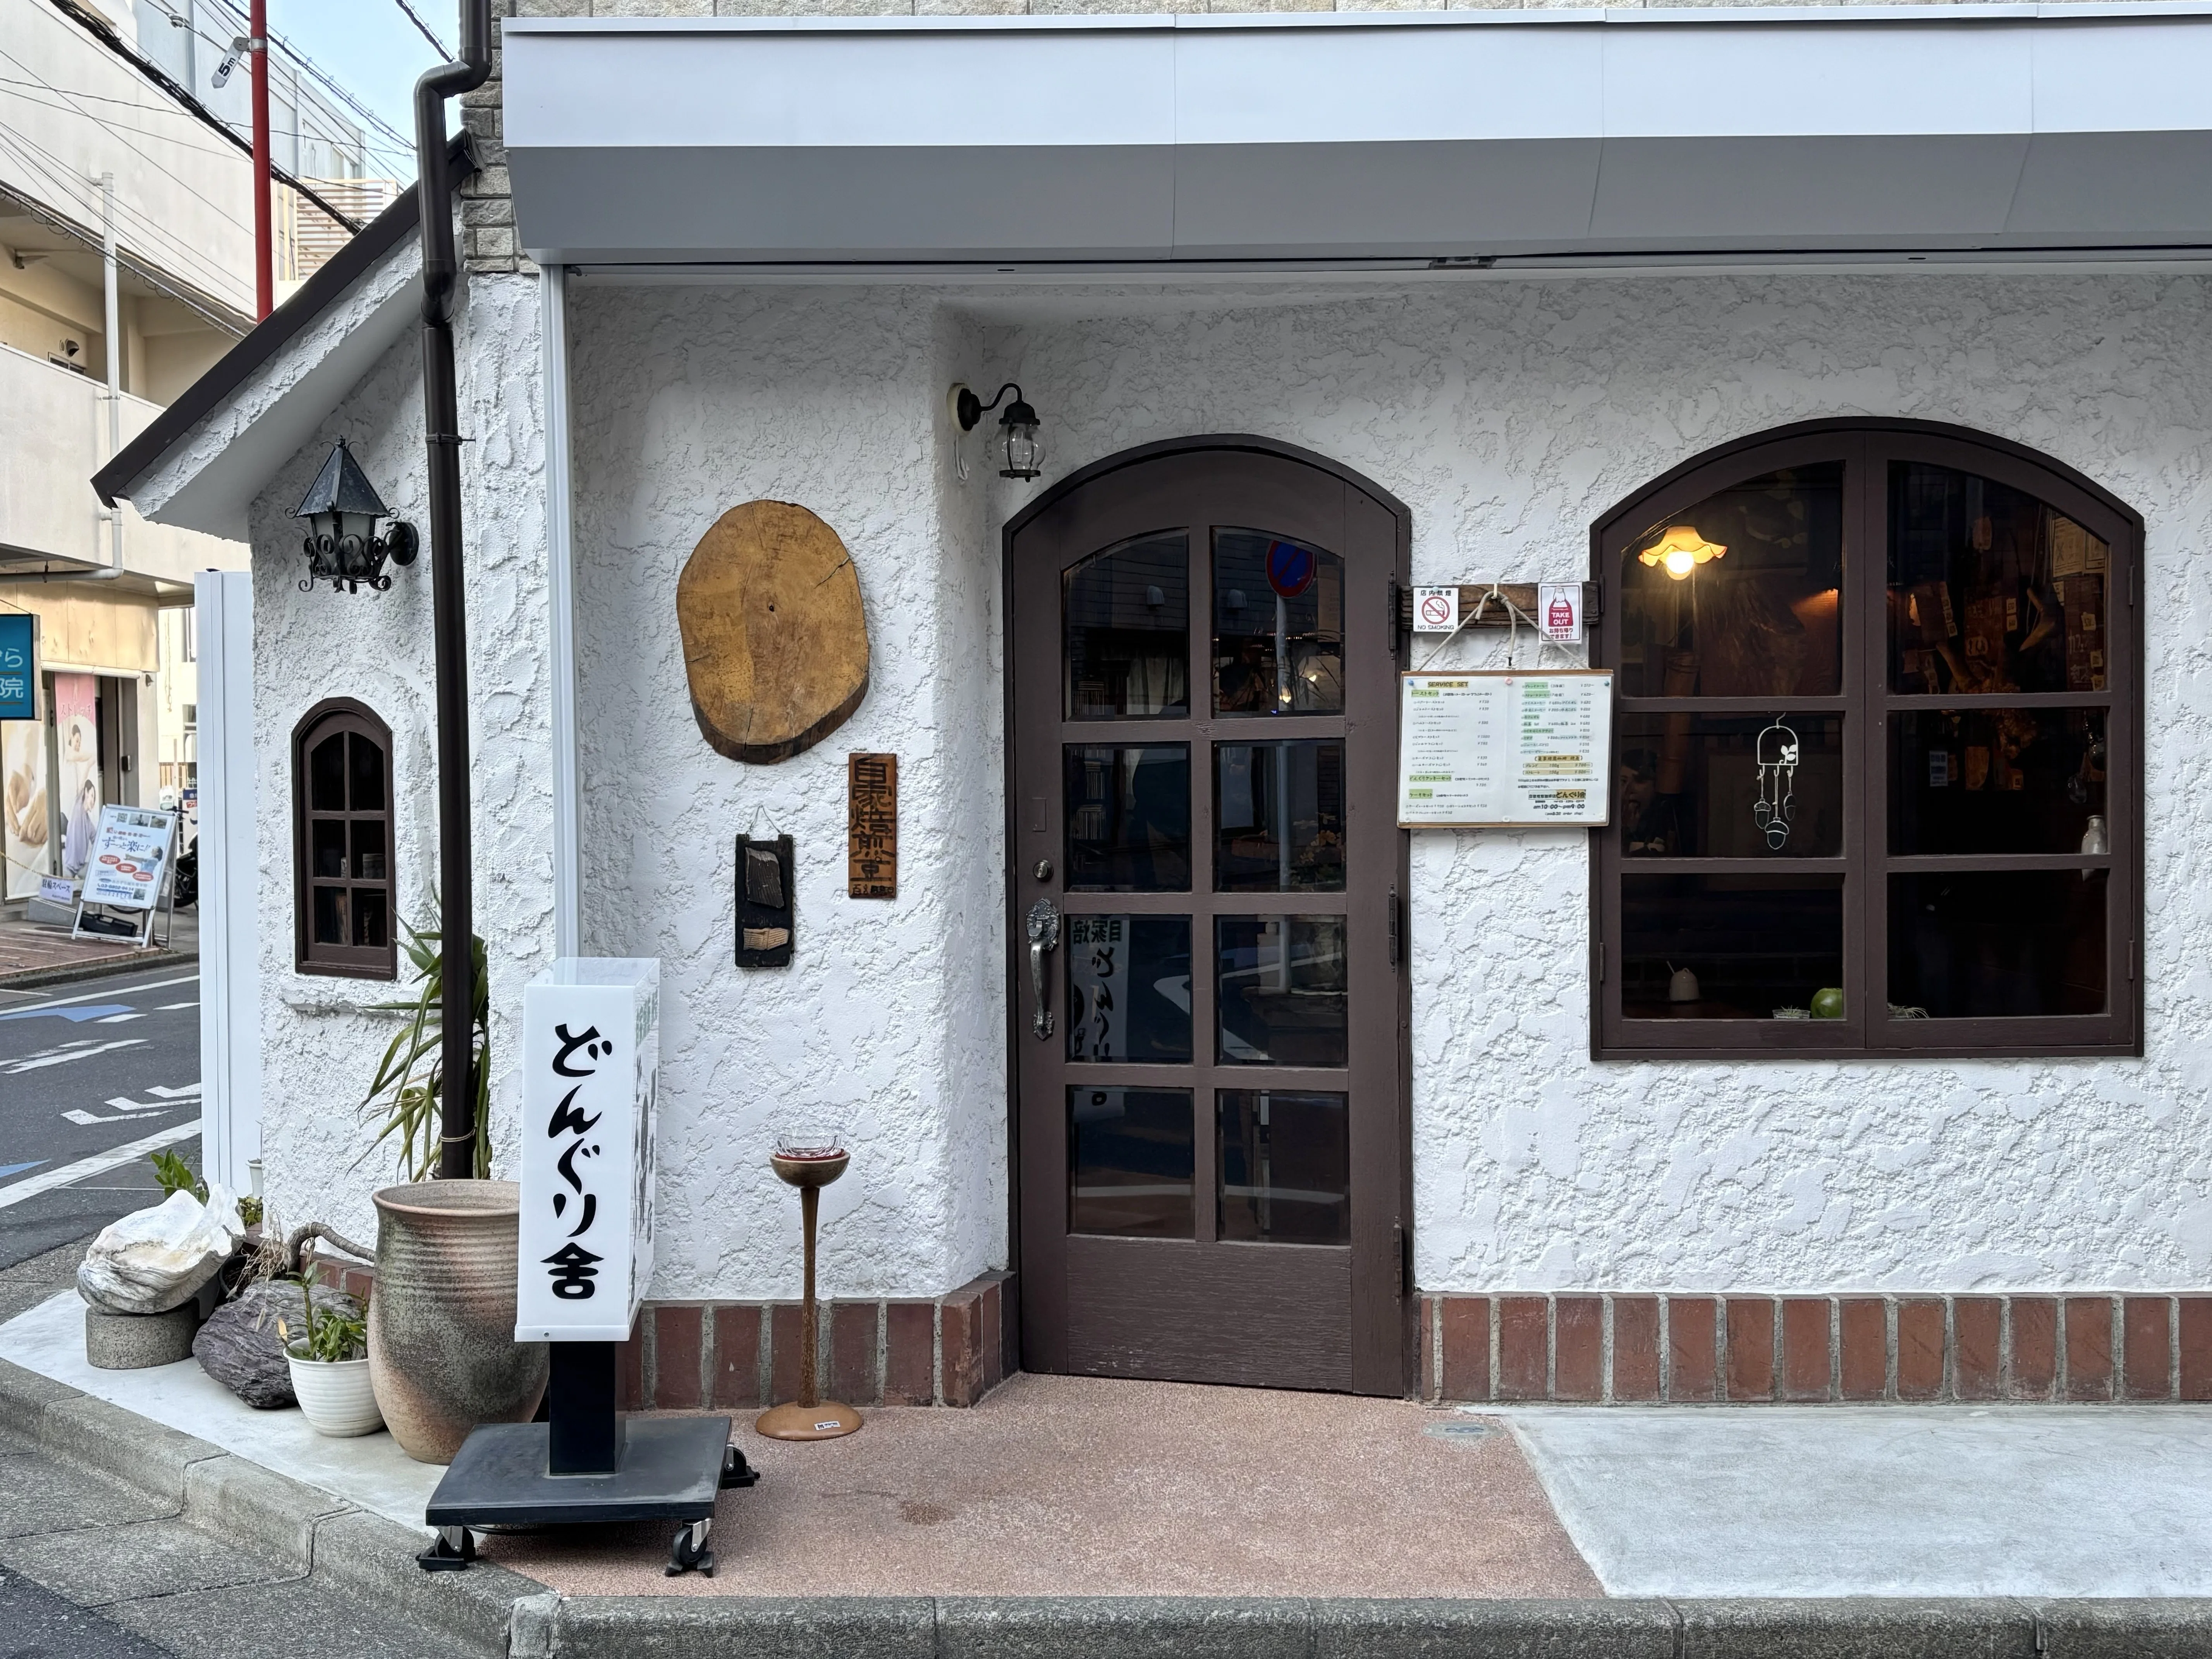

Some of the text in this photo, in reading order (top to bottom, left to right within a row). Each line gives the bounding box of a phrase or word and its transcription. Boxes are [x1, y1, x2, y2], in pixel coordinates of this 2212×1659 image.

[218, 57, 236, 77] 5m
[0, 648, 23, 668] ら
[61, 703, 92, 717] ストレッチ
[540, 1023, 613, 1300] どんぐり舎
